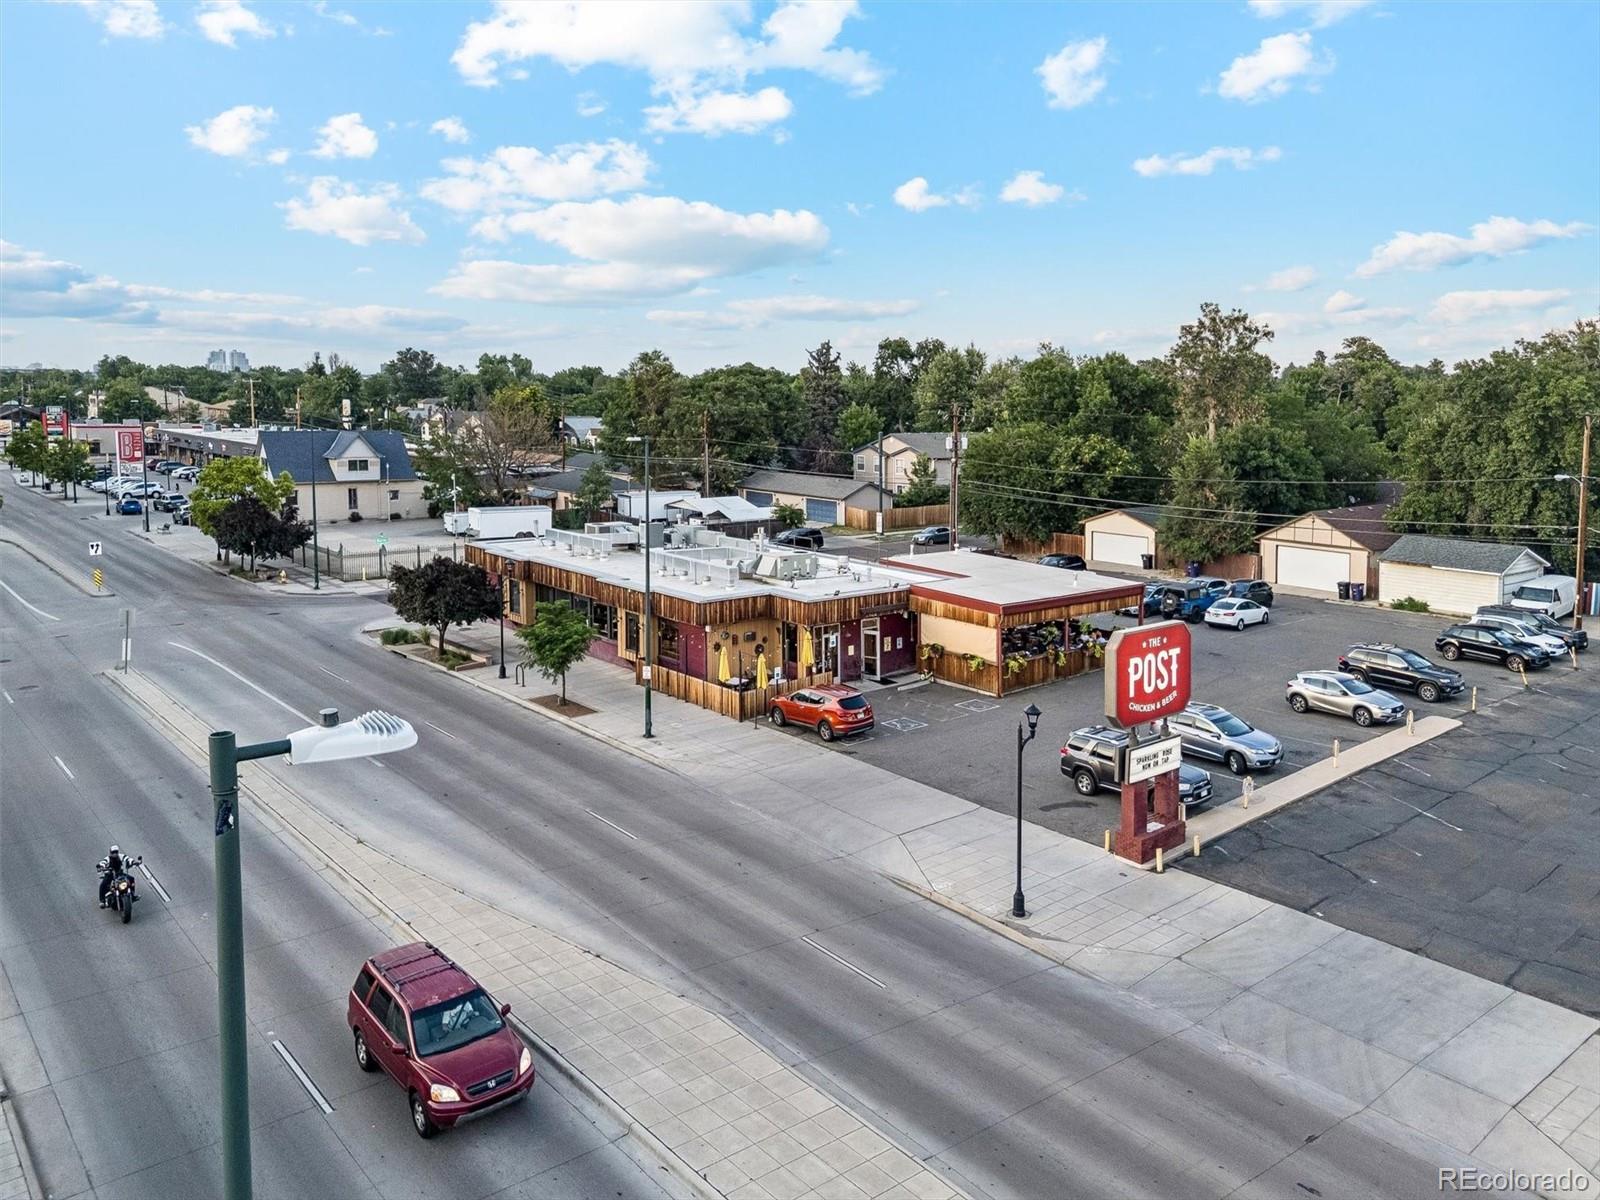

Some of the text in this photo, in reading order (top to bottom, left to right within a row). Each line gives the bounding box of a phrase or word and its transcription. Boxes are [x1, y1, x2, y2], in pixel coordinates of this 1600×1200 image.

[1149, 637, 1161, 648] THE
[1128, 647, 1181, 698] POST
[1128, 702, 1156, 712] CHICKEN
[1161, 690, 1178, 706] BEER
